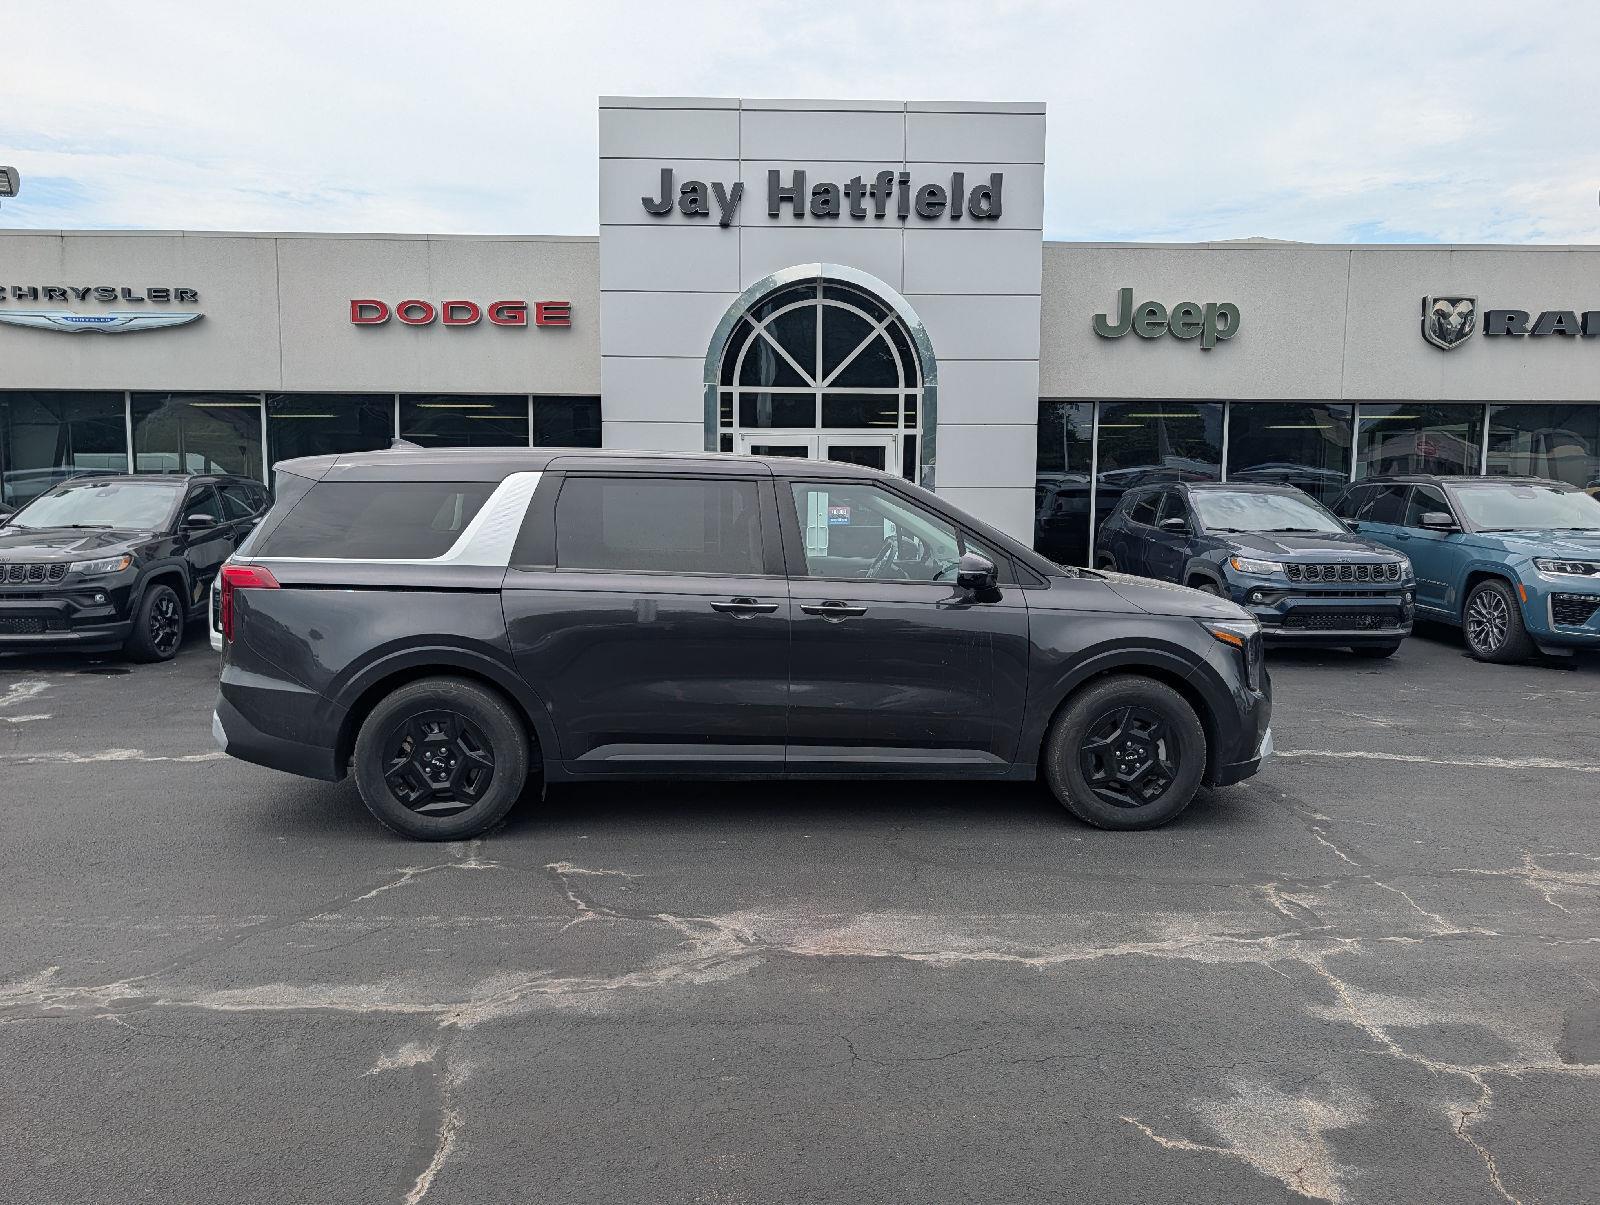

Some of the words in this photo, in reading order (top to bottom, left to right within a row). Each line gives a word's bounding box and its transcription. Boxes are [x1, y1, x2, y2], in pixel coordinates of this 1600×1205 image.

[641, 168, 745, 228] Jay
[767, 169, 1004, 220] Hatfield
[0, 285, 199, 302] HRYSLER
[350, 299, 572, 328] DODGE
[1092, 287, 1241, 351] Jeep
